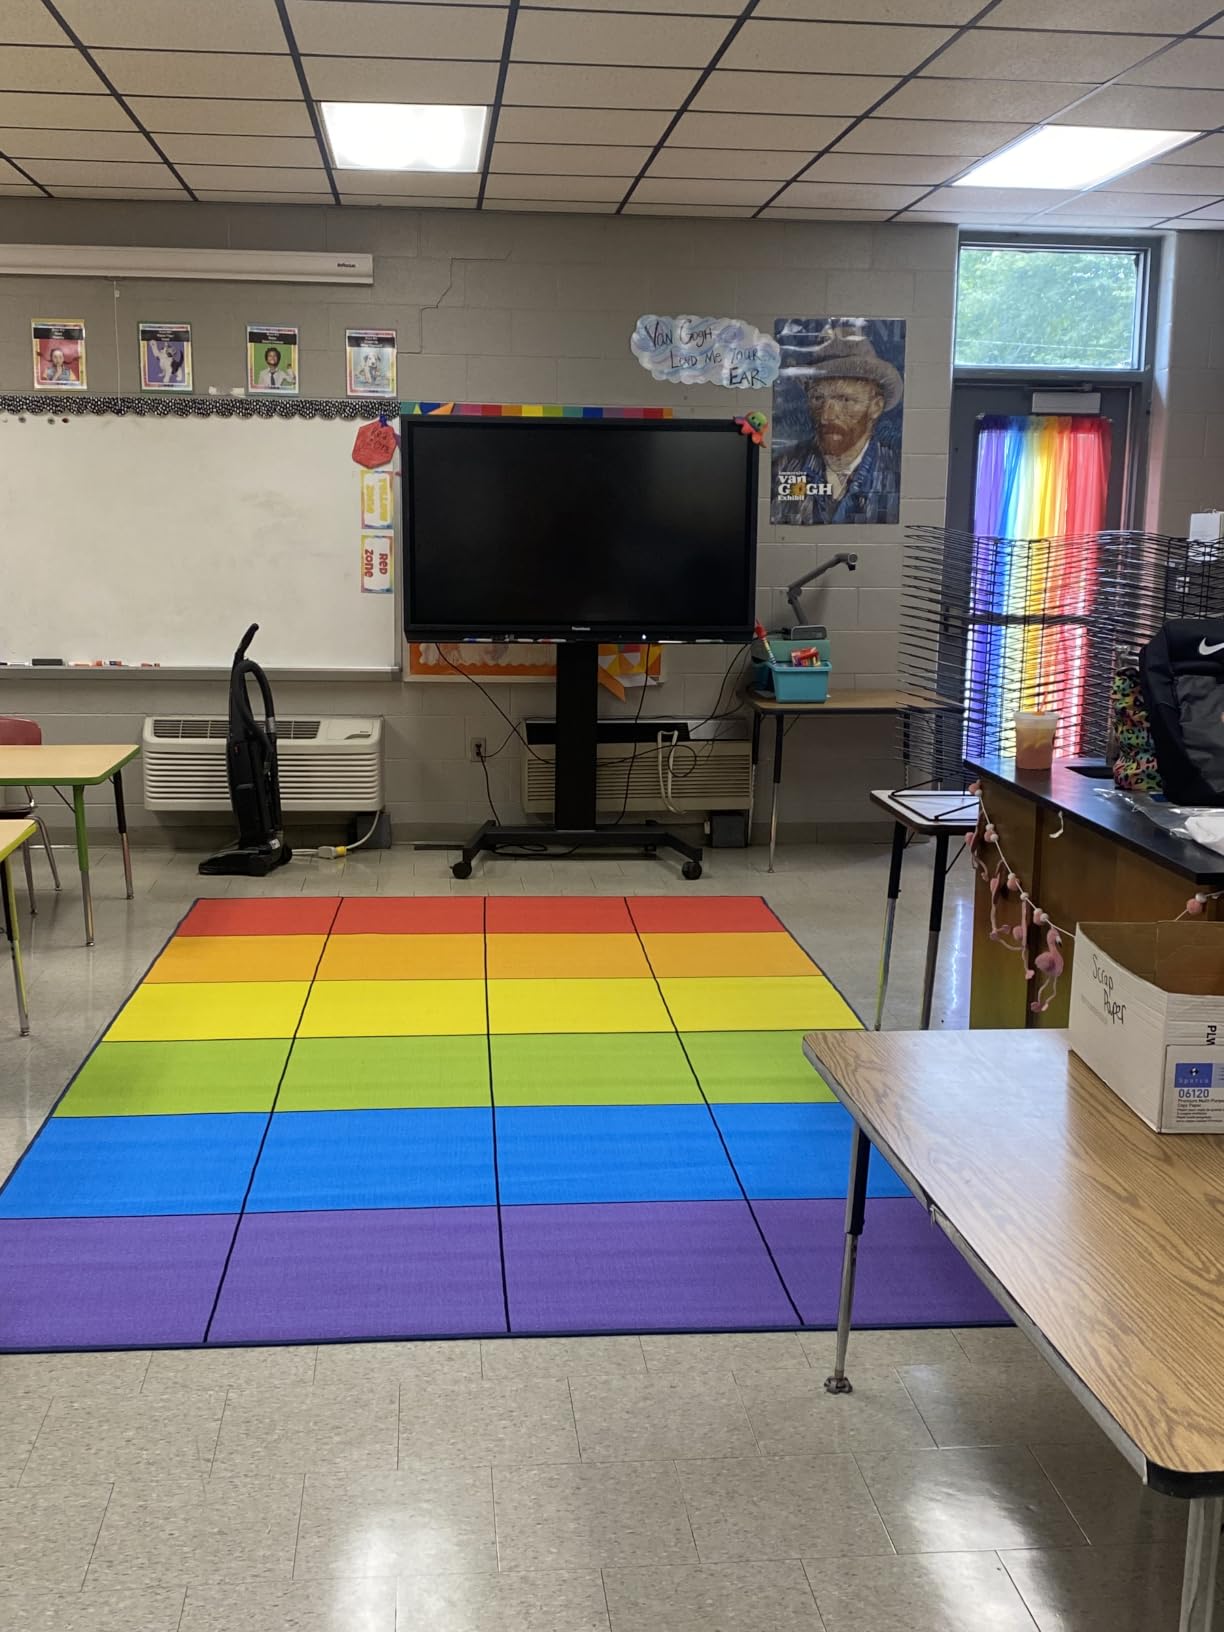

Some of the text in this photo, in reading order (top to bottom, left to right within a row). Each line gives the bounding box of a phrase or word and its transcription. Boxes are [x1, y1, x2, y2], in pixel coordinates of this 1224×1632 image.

[729, 366, 767, 386] EAR
[778, 475, 807, 484] van
[1093, 953, 1114, 998] Scrap
[1103, 987, 1127, 1025] Paper
[1178, 1088, 1210, 1099] 06120
